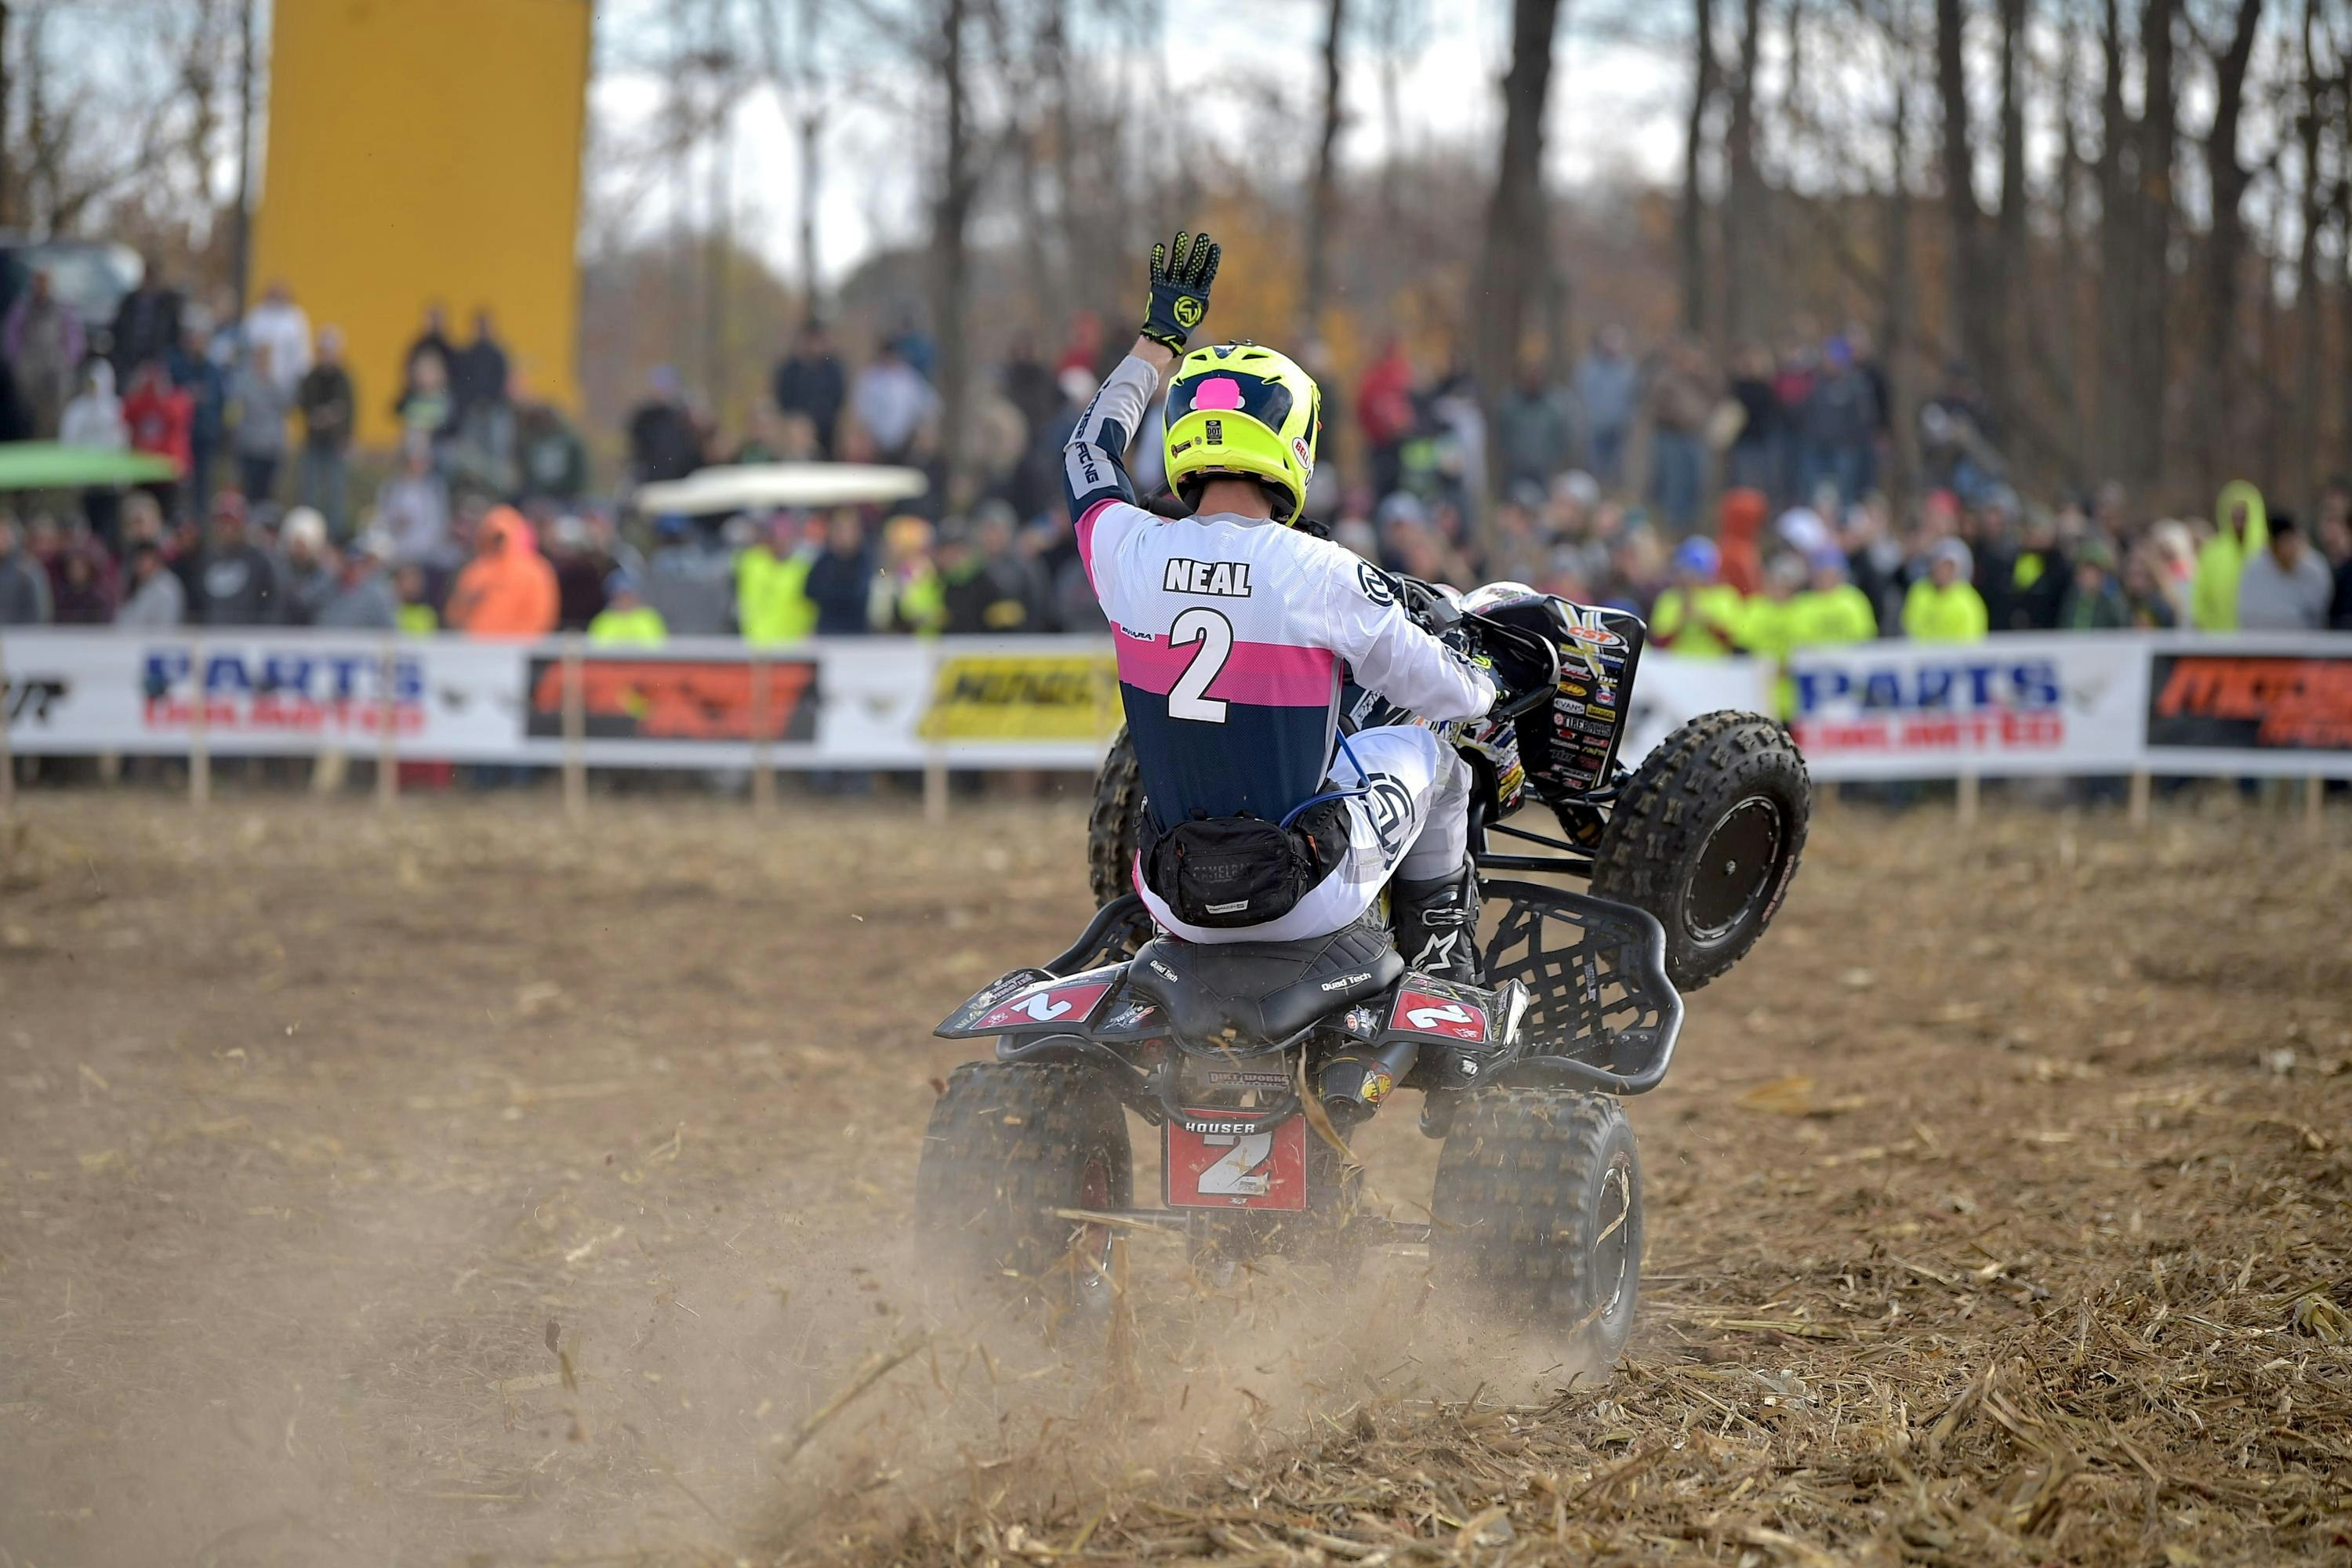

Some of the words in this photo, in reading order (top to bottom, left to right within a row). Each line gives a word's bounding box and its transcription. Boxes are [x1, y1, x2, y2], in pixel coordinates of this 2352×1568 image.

[1295, 441, 1308, 466] BELL
[1163, 558, 1252, 597] NEAL
[1568, 626, 1613, 643] CST
[143, 655, 424, 698] PARTS
[1168, 606, 1233, 724] 2
[1798, 662, 2060, 709] PARTS
[1555, 699, 1584, 713] EVANS
[1150, 960, 1166, 974] Quad
[1164, 969, 1178, 983] Tech
[1322, 978, 1348, 992] Quad
[1348, 972, 1372, 985] Tech
[1010, 992, 1073, 1022] 2
[1406, 1004, 1473, 1029] 2
[1242, 1073, 1290, 1087] WORKS
[1185, 1122, 1255, 1134] HOUSER
[1198, 1131, 1272, 1196] 2
